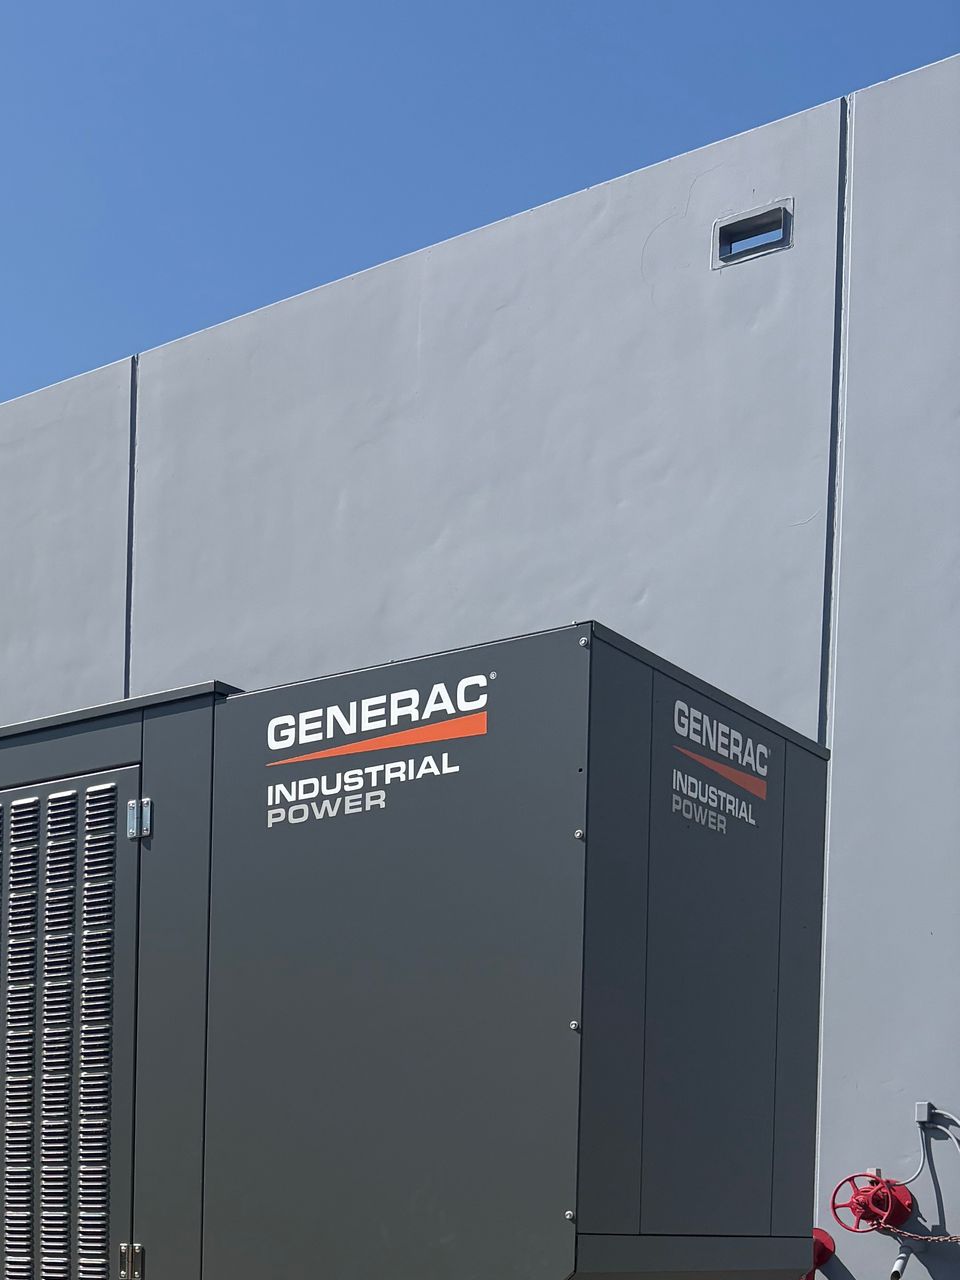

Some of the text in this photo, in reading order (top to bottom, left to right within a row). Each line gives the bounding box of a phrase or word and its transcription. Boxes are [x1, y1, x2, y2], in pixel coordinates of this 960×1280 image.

[266, 673, 488, 751] GENERAC
[674, 699, 768, 777] GENERAC
[267, 752, 460, 806] INDUSTRIAL
[672, 769, 756, 826] INDUSTRIAL
[267, 789, 386, 829] POWER
[672, 794, 727, 835] POWER
